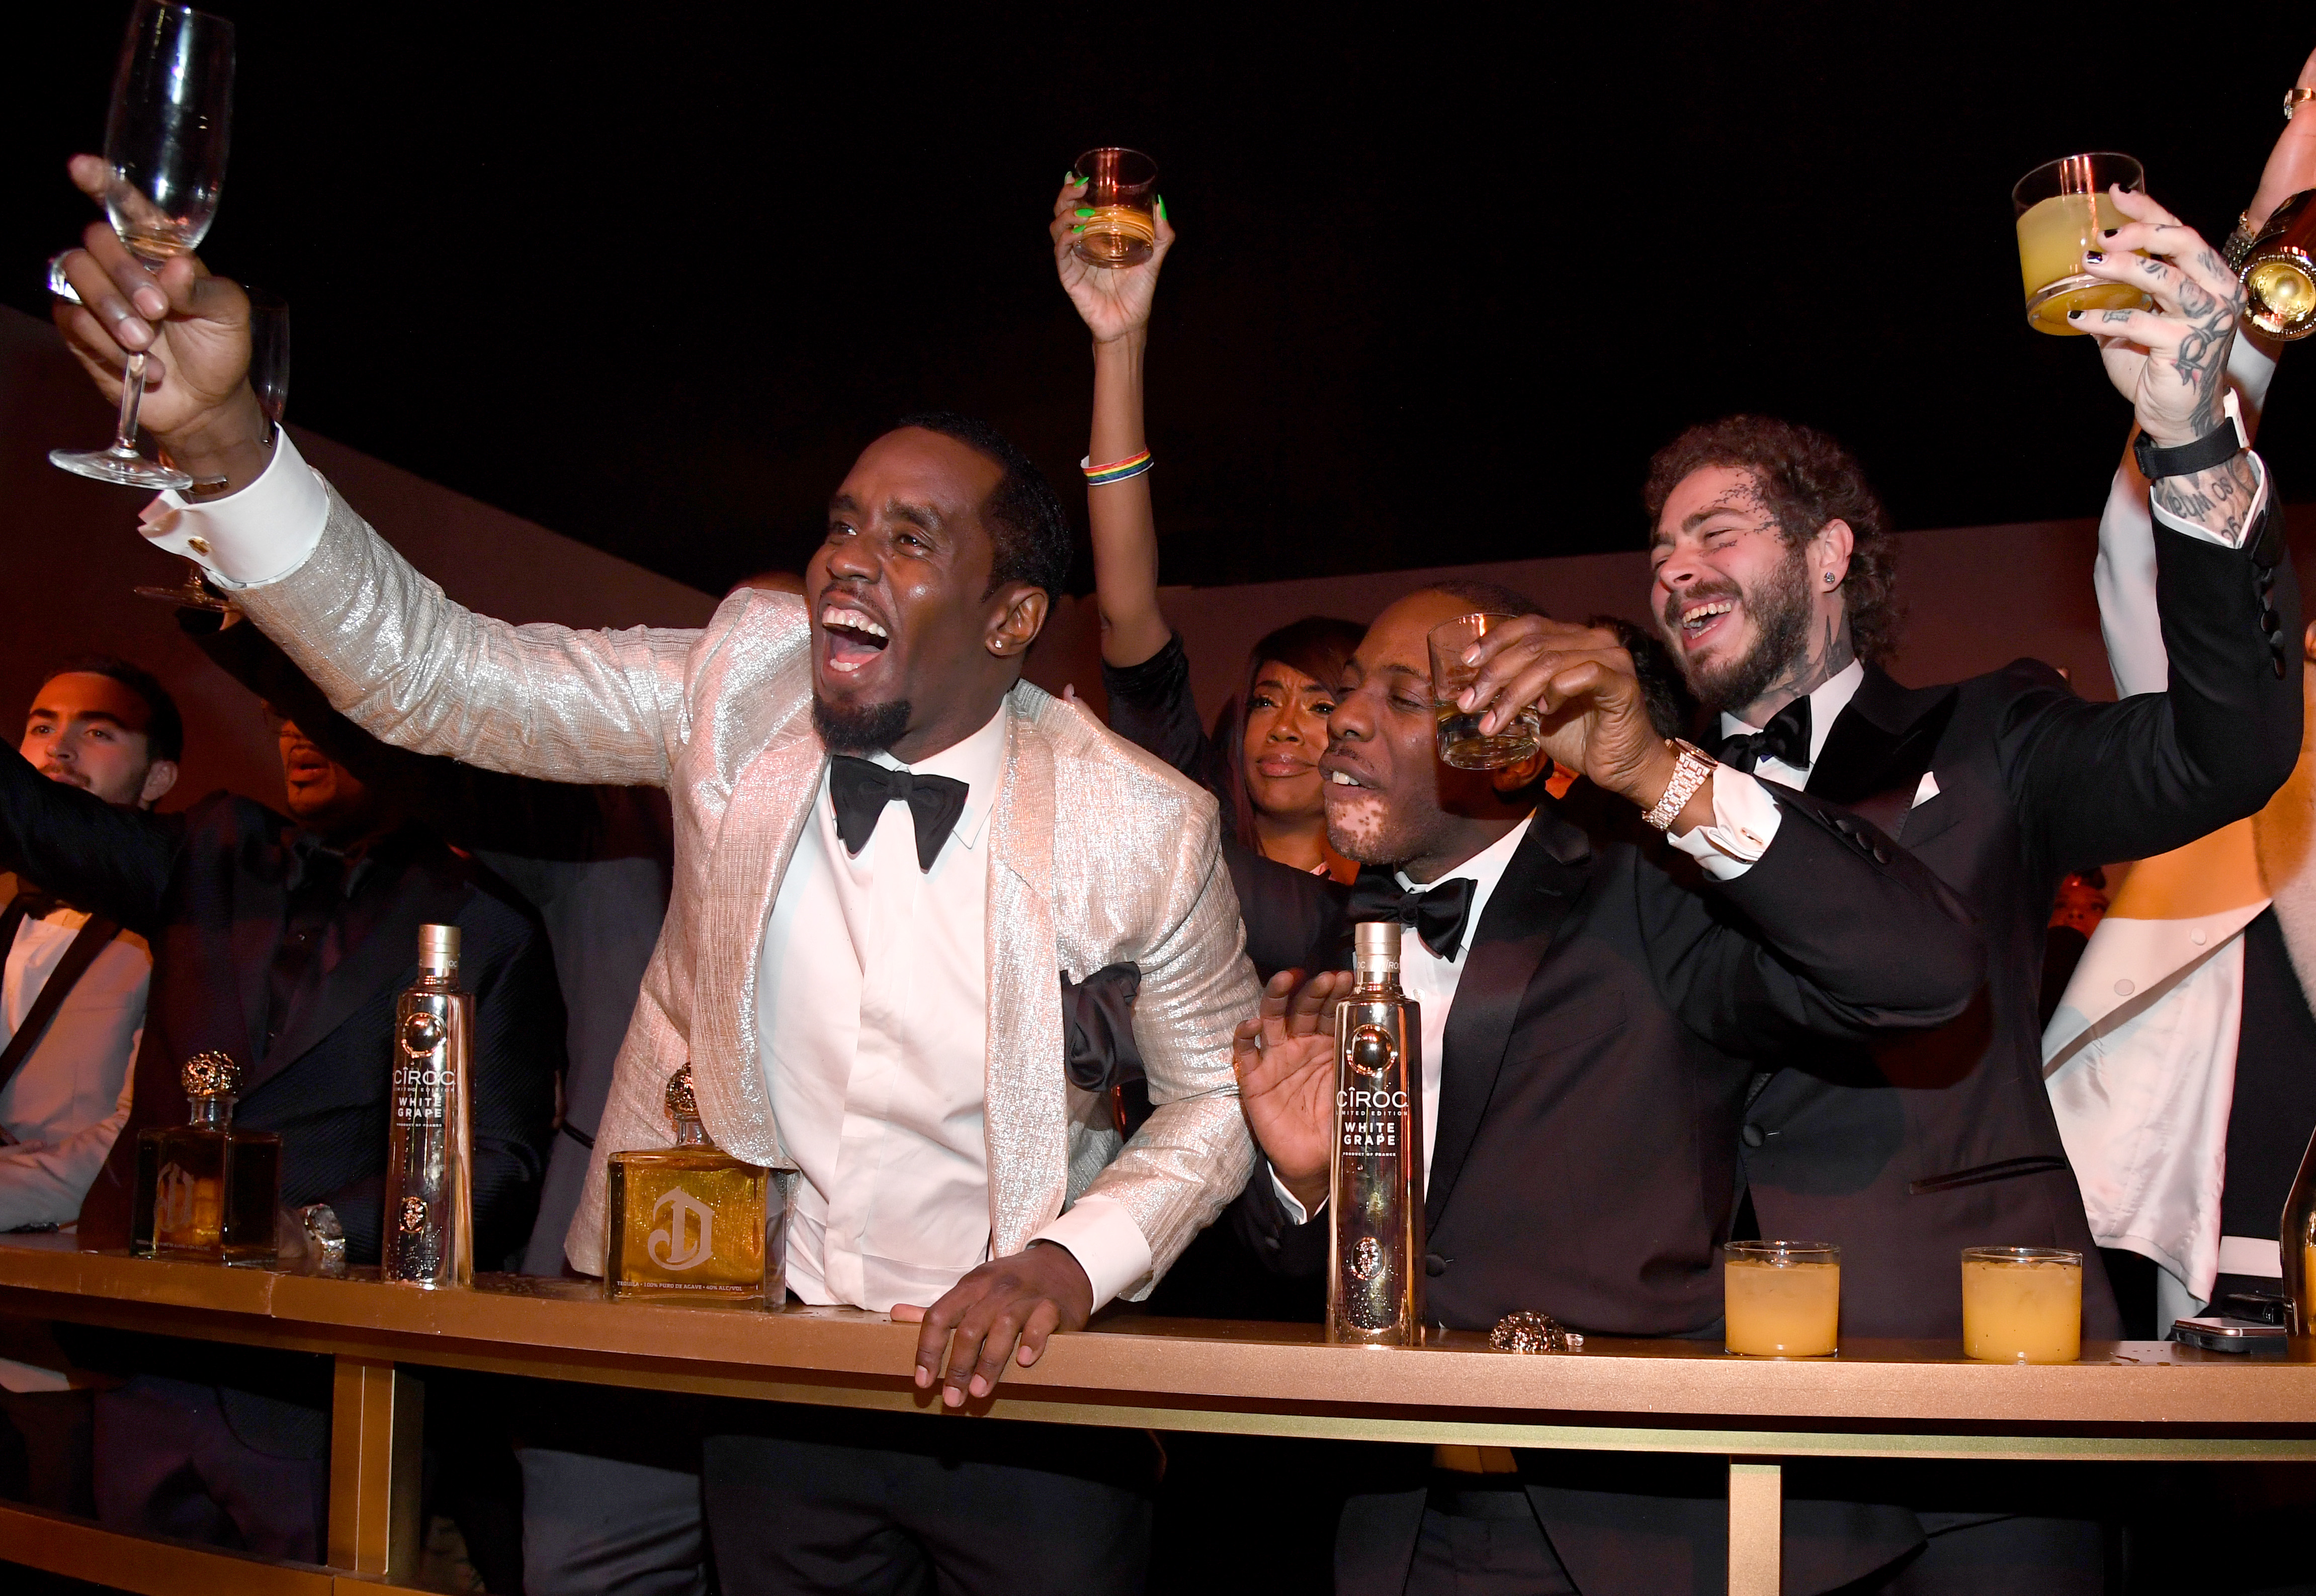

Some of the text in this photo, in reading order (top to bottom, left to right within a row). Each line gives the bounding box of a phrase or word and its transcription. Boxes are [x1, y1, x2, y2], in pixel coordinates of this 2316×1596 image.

[395, 1067, 455, 1086] CÎROC
[399, 1097, 442, 1107] WHITE
[1336, 1087, 1407, 1108] CÎROC
[398, 1108, 442, 1118] GRAPE
[1345, 1122, 1395, 1133] WHITE
[1344, 1134, 1395, 1146] GRAPE
